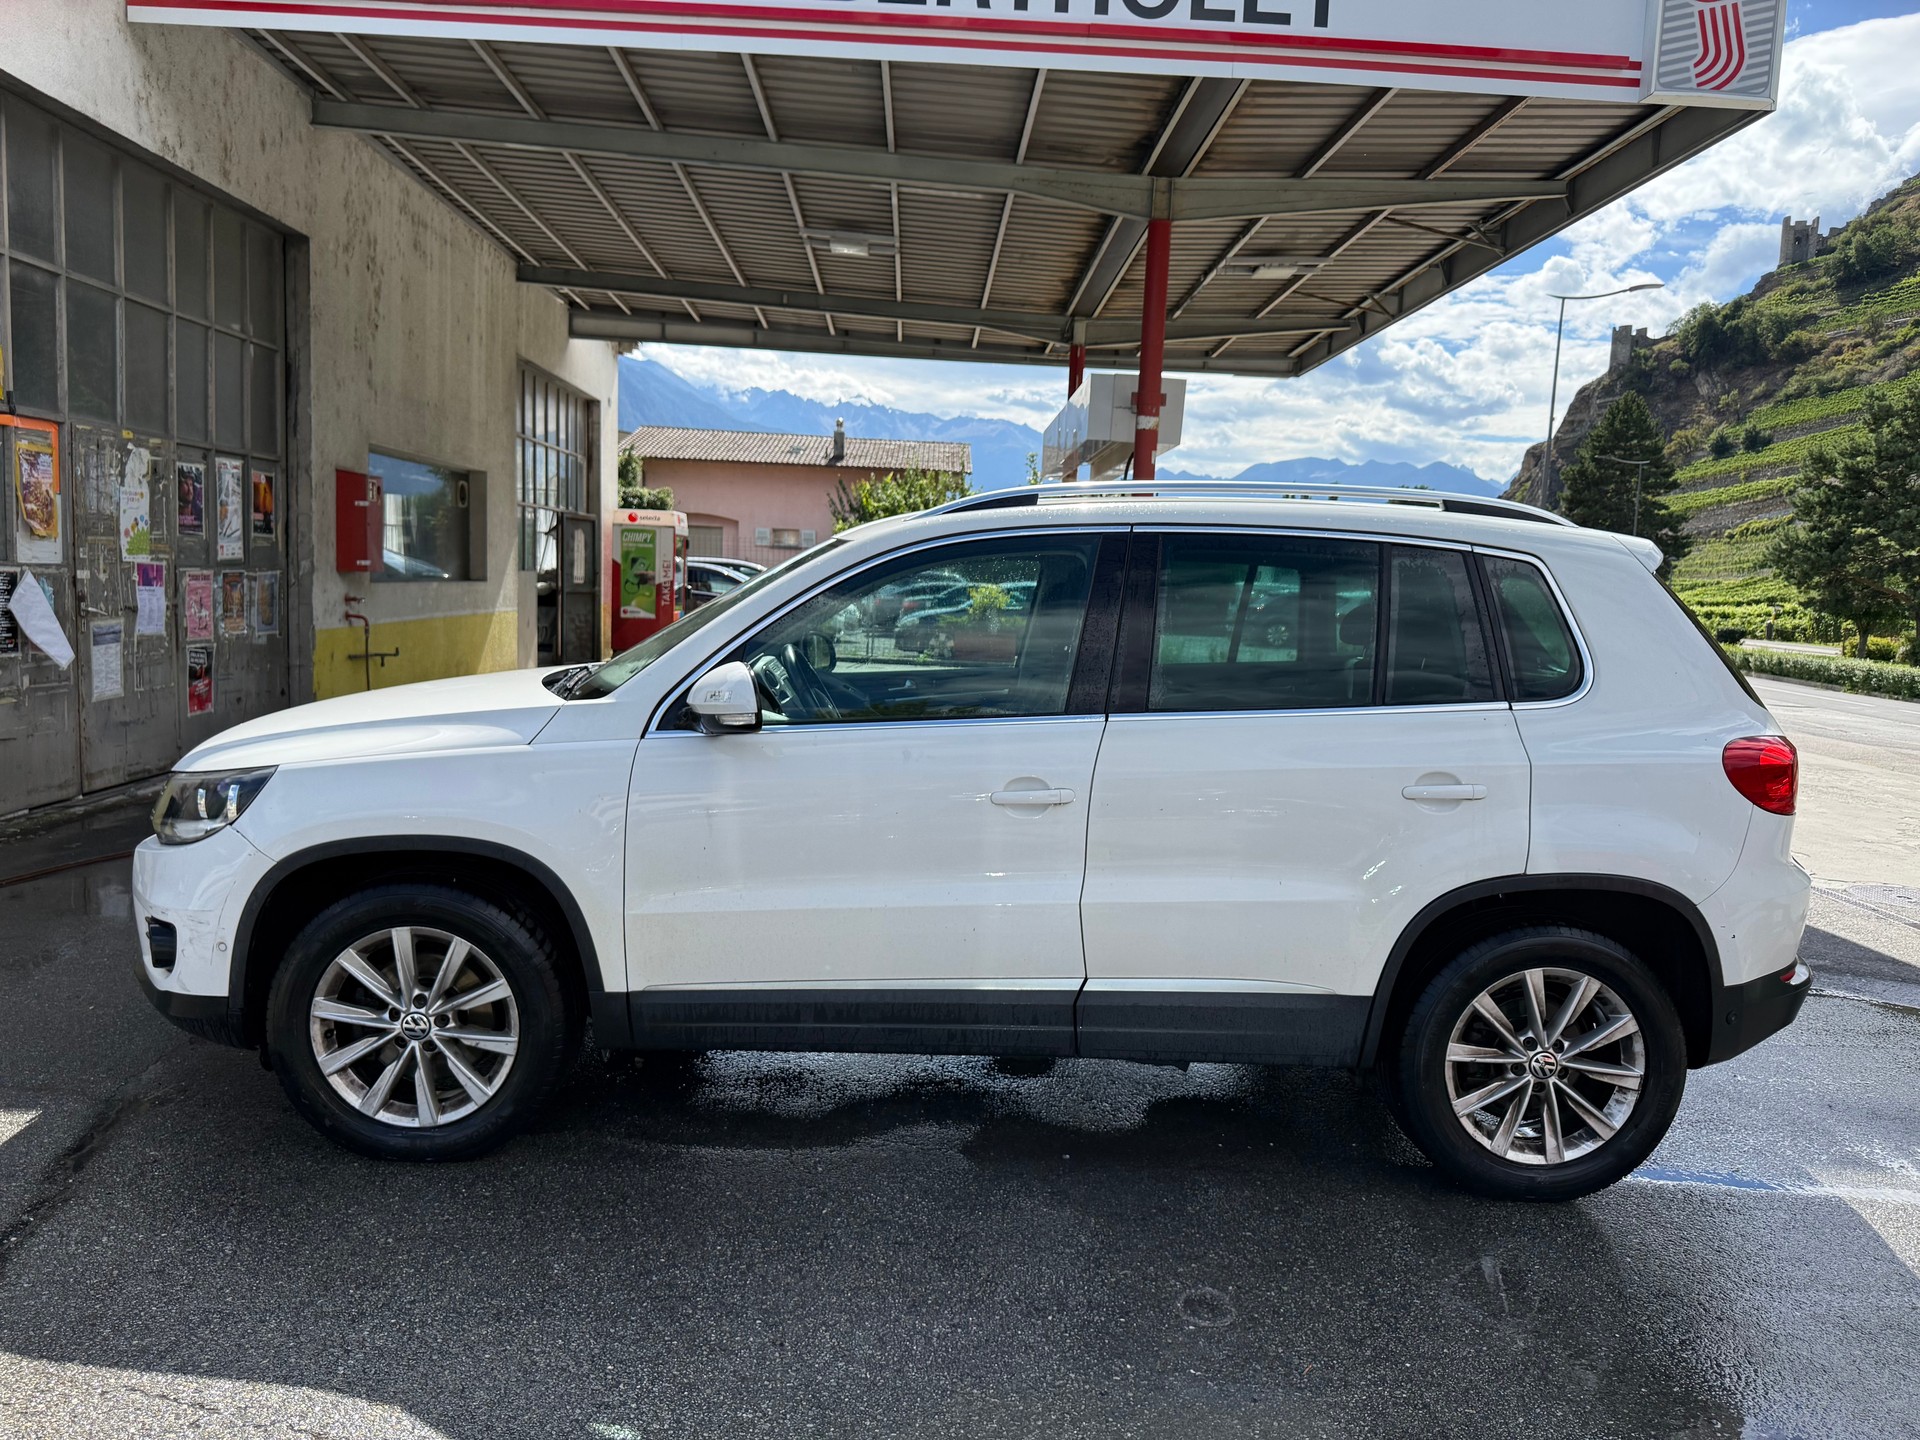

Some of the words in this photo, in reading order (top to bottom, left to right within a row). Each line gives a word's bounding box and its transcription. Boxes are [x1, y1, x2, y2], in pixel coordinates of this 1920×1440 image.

[622, 531, 652, 543] CHIMPY
[662, 559, 671, 579] ME!
[661, 580, 671, 607] TAKE
